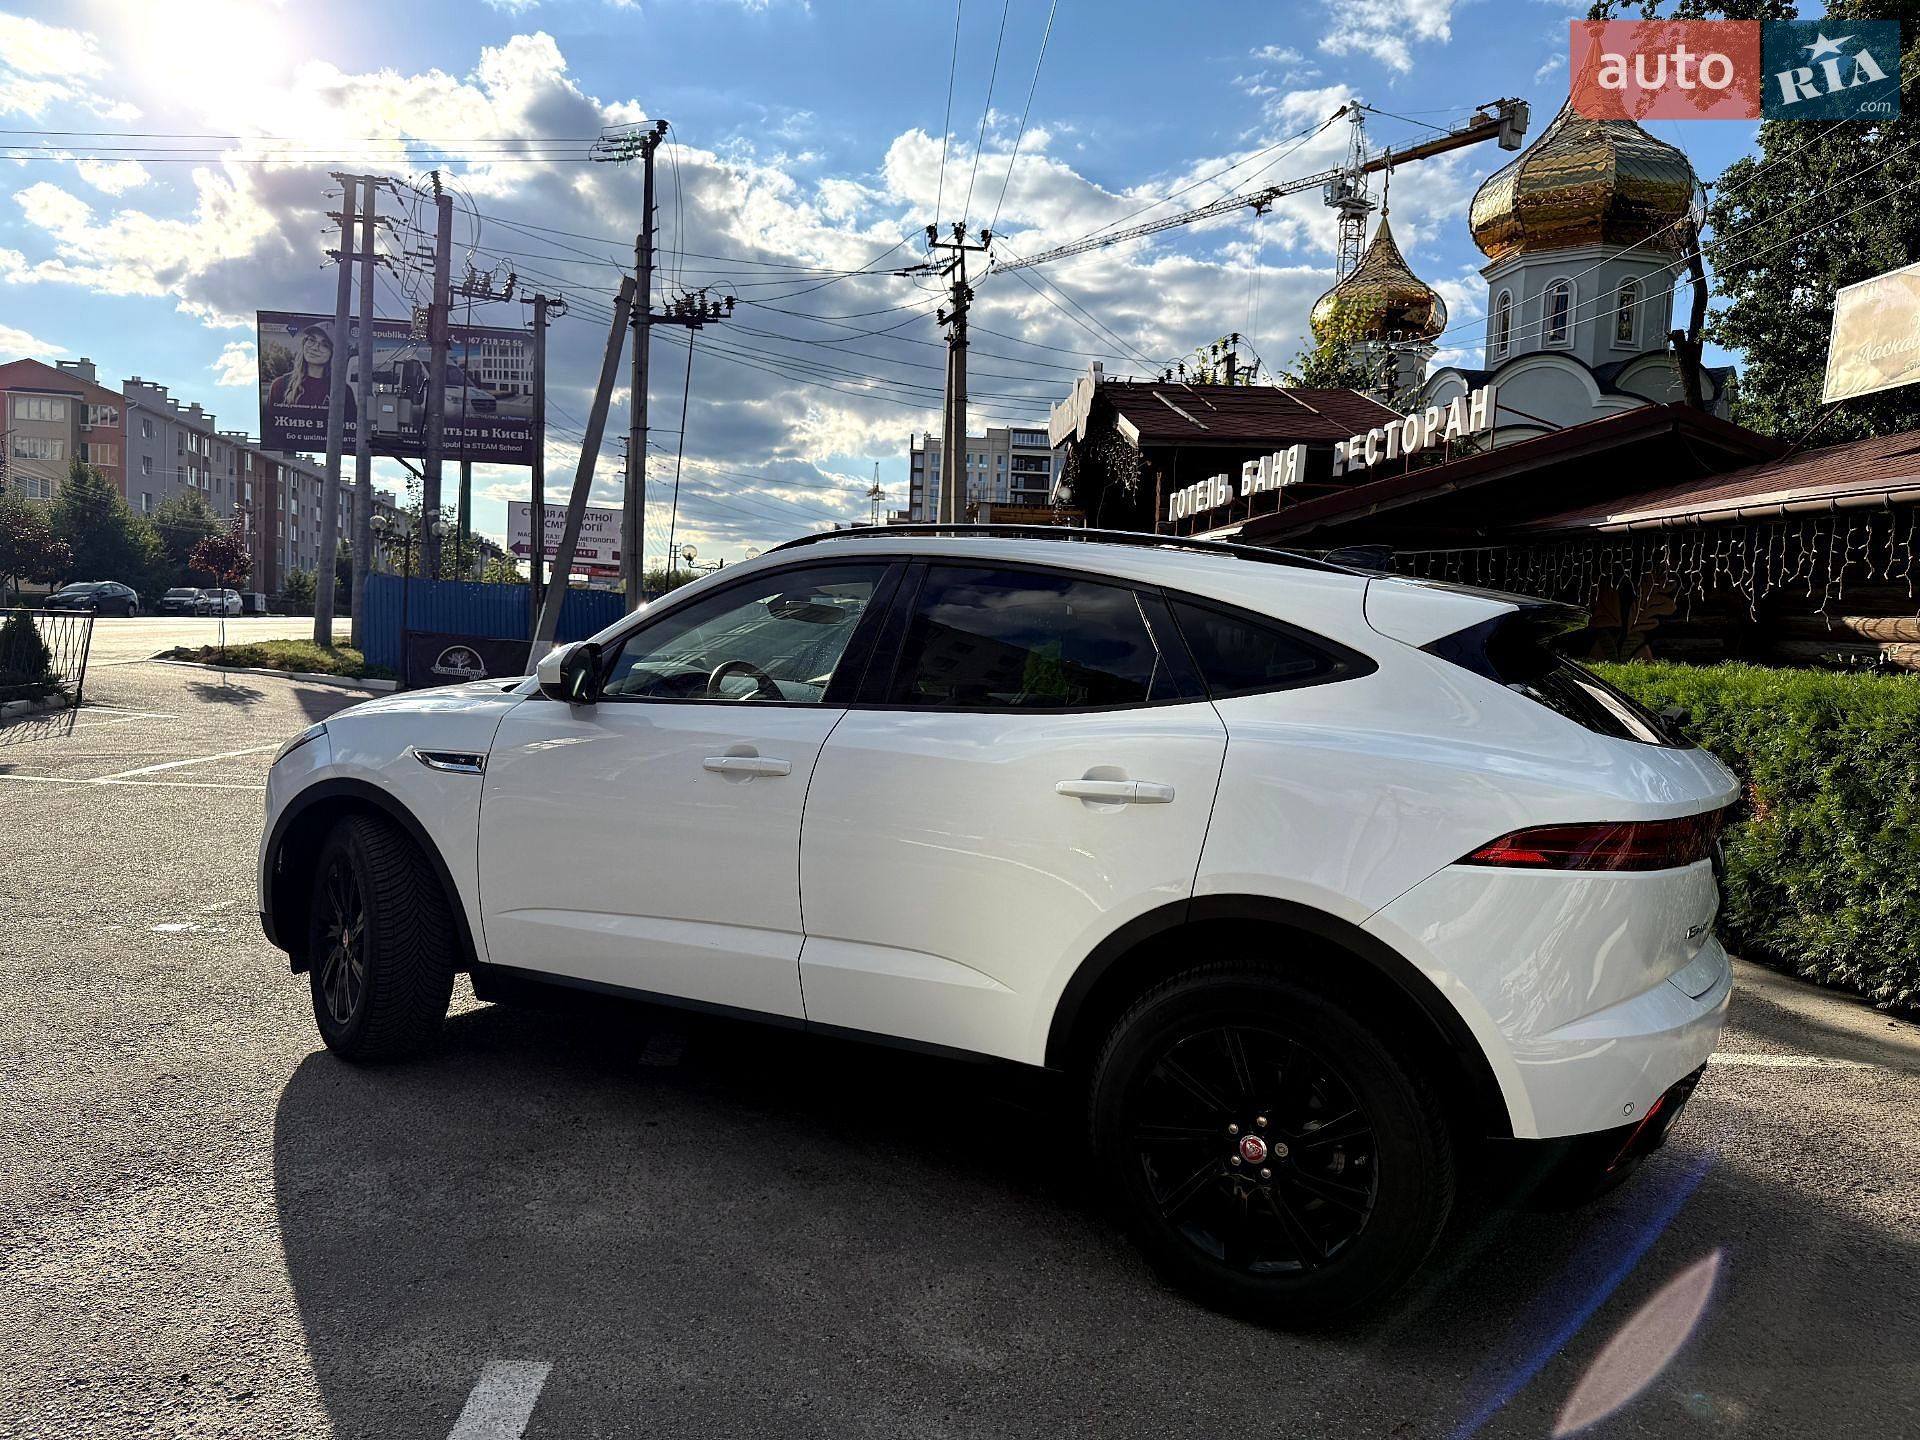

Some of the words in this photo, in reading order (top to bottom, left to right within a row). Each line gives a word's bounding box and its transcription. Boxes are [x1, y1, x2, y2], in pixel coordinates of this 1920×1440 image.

[275, 416, 313, 428] Живе
[316, 420, 324, 428] в
[286, 432, 296, 440] Бо
[481, 429, 488, 437] в
[492, 428, 533, 440] Києві.
[471, 442, 498, 450] STEAM
[499, 443, 523, 452] School
[1169, 474, 1233, 522] ГОТЕЛЬ
[1241, 444, 1307, 497] БАНЯ
[1333, 385, 1497, 477] РЕСТОРАН
